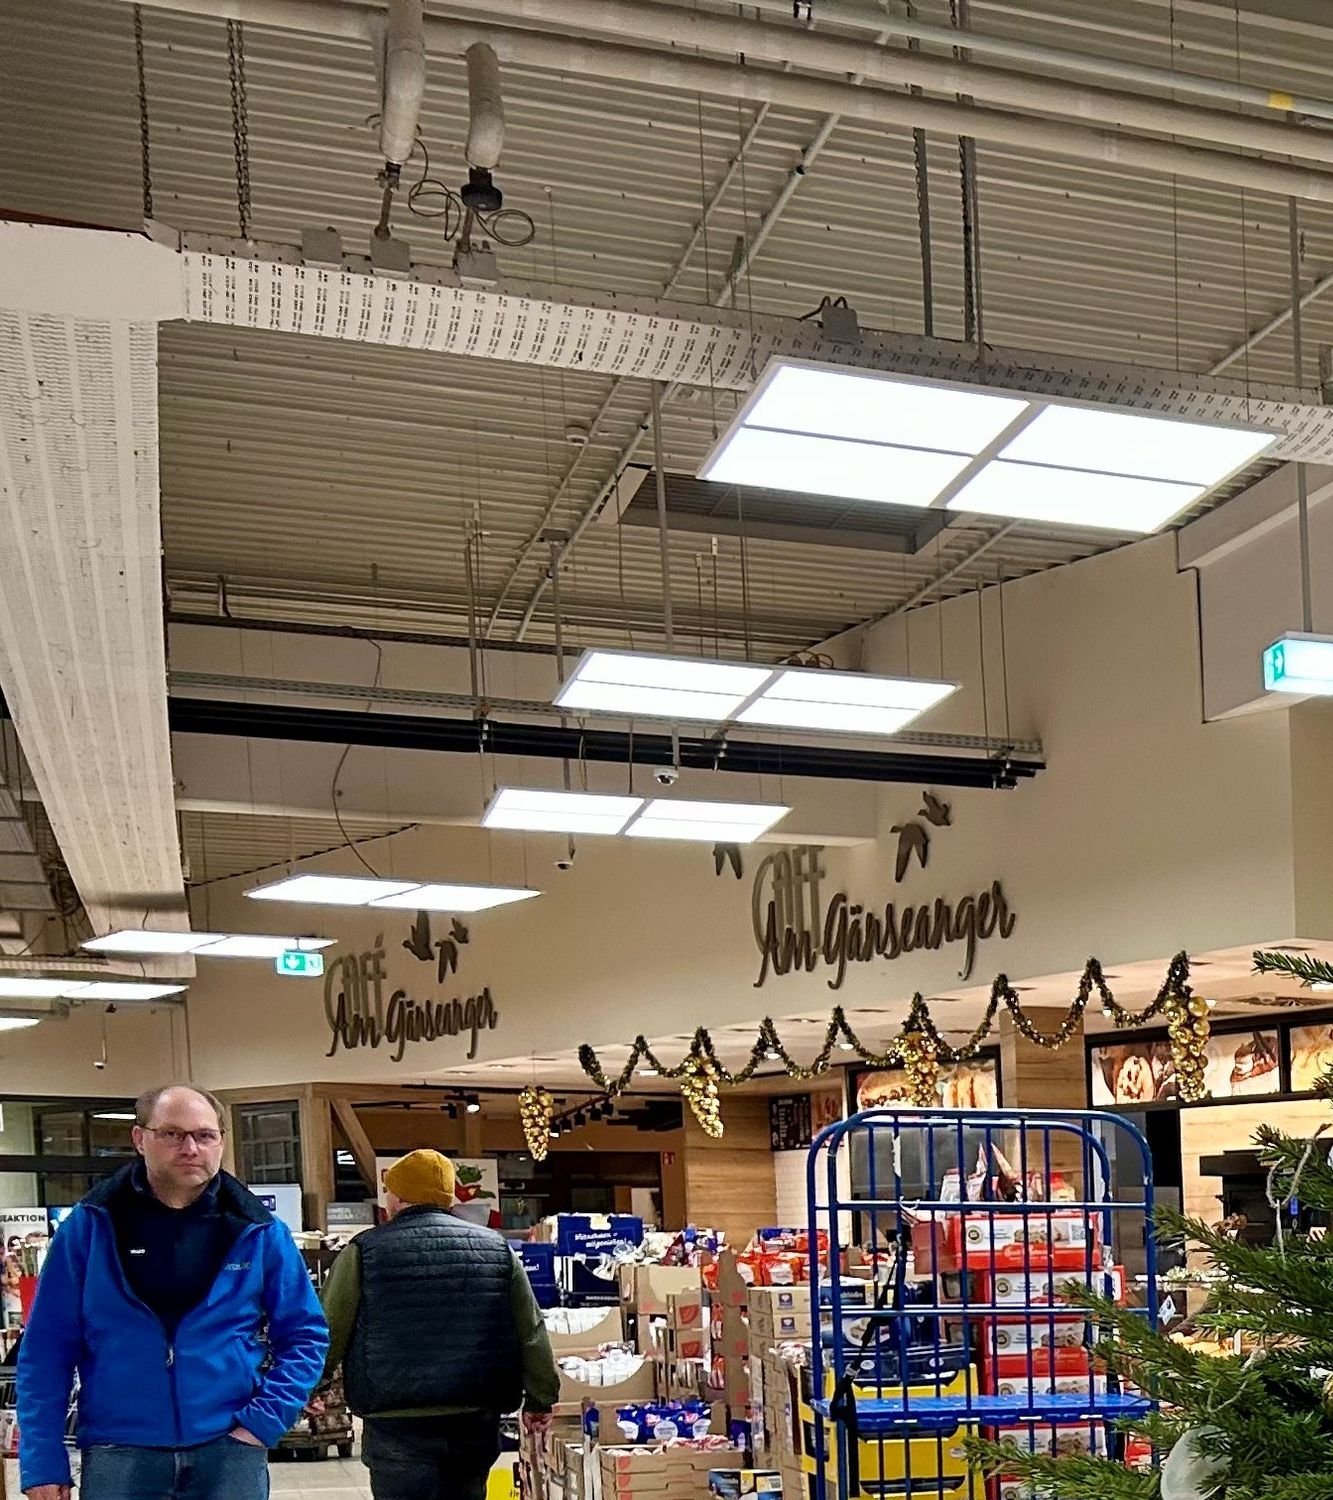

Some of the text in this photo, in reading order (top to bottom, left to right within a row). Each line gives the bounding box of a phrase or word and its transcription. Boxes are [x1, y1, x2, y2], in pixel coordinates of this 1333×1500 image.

[753, 880, 1016, 990] Am Gänseanger
[325, 987, 498, 1062] Am Gänseanger
